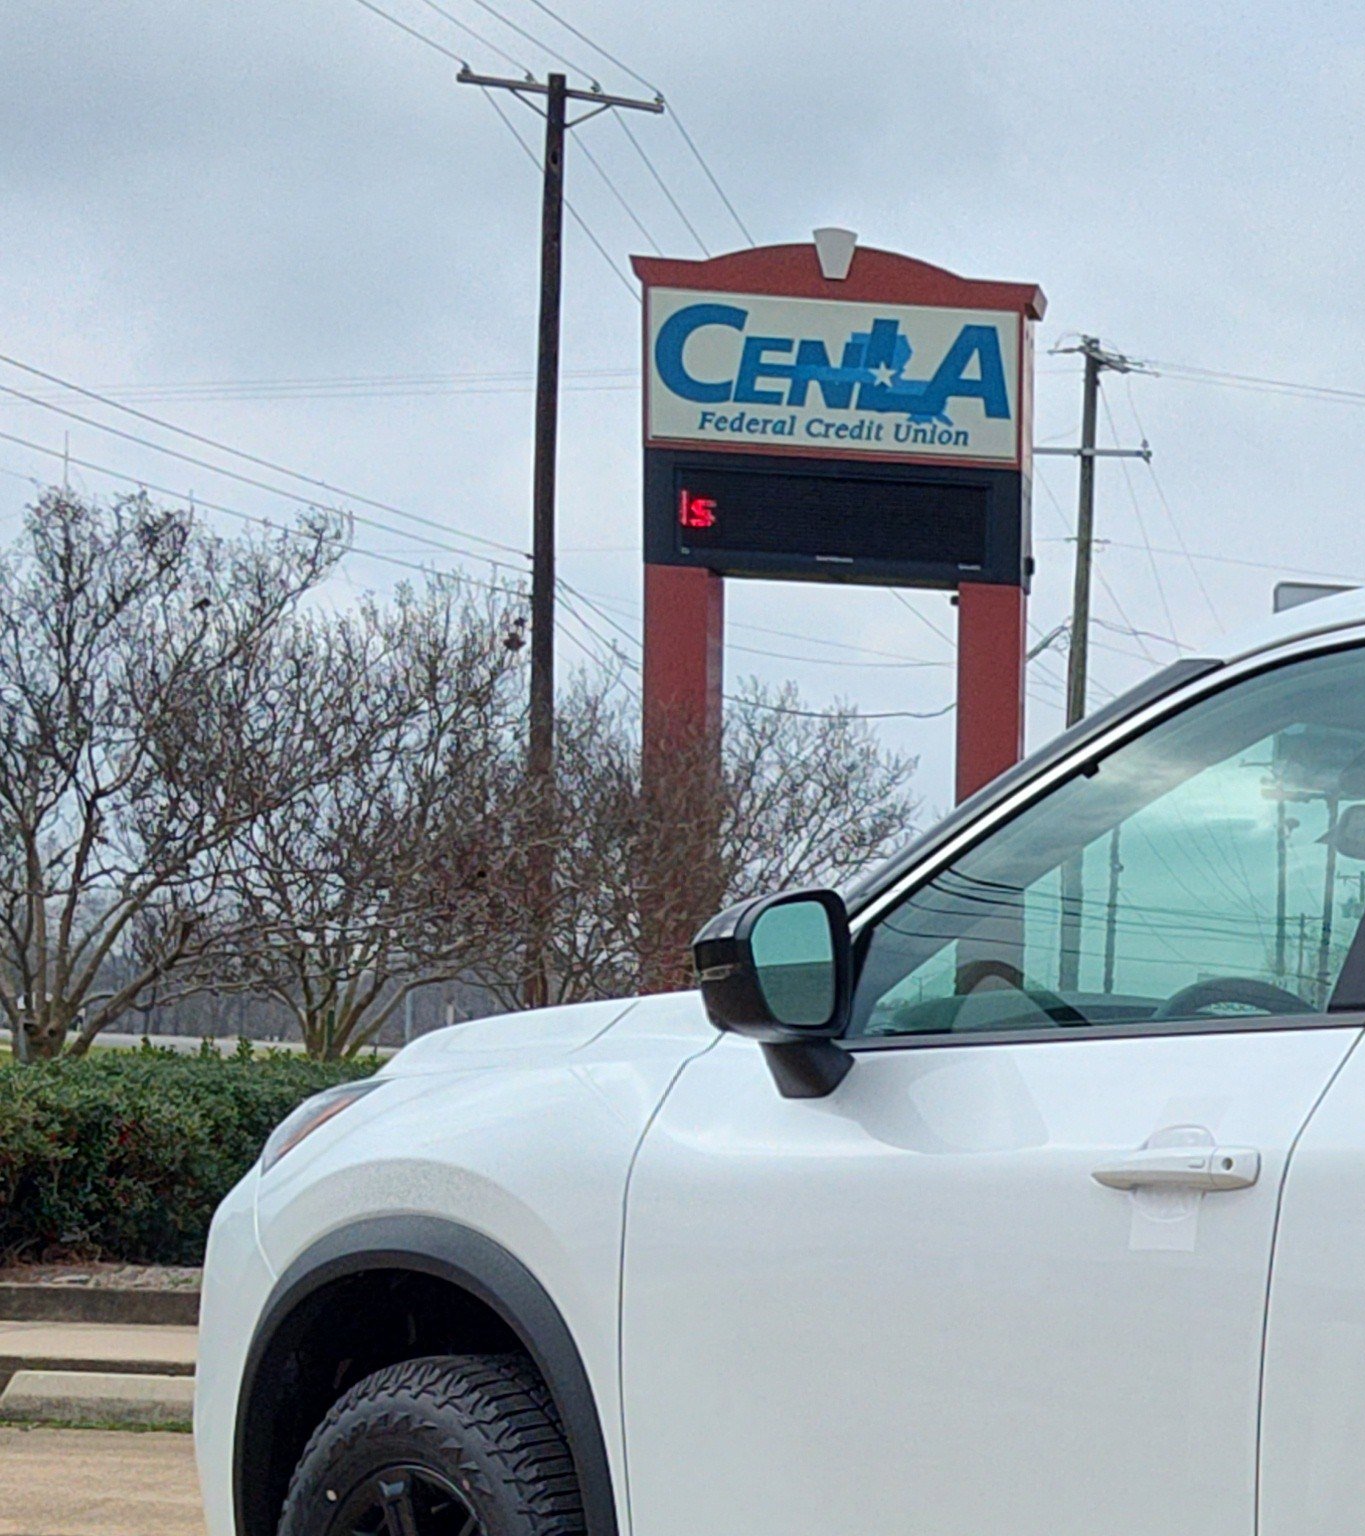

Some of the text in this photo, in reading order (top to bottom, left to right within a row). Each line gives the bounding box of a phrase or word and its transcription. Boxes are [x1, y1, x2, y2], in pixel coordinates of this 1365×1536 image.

[654, 303, 1012, 420] CENLA
[697, 411, 970, 447] Federal Credit Union
